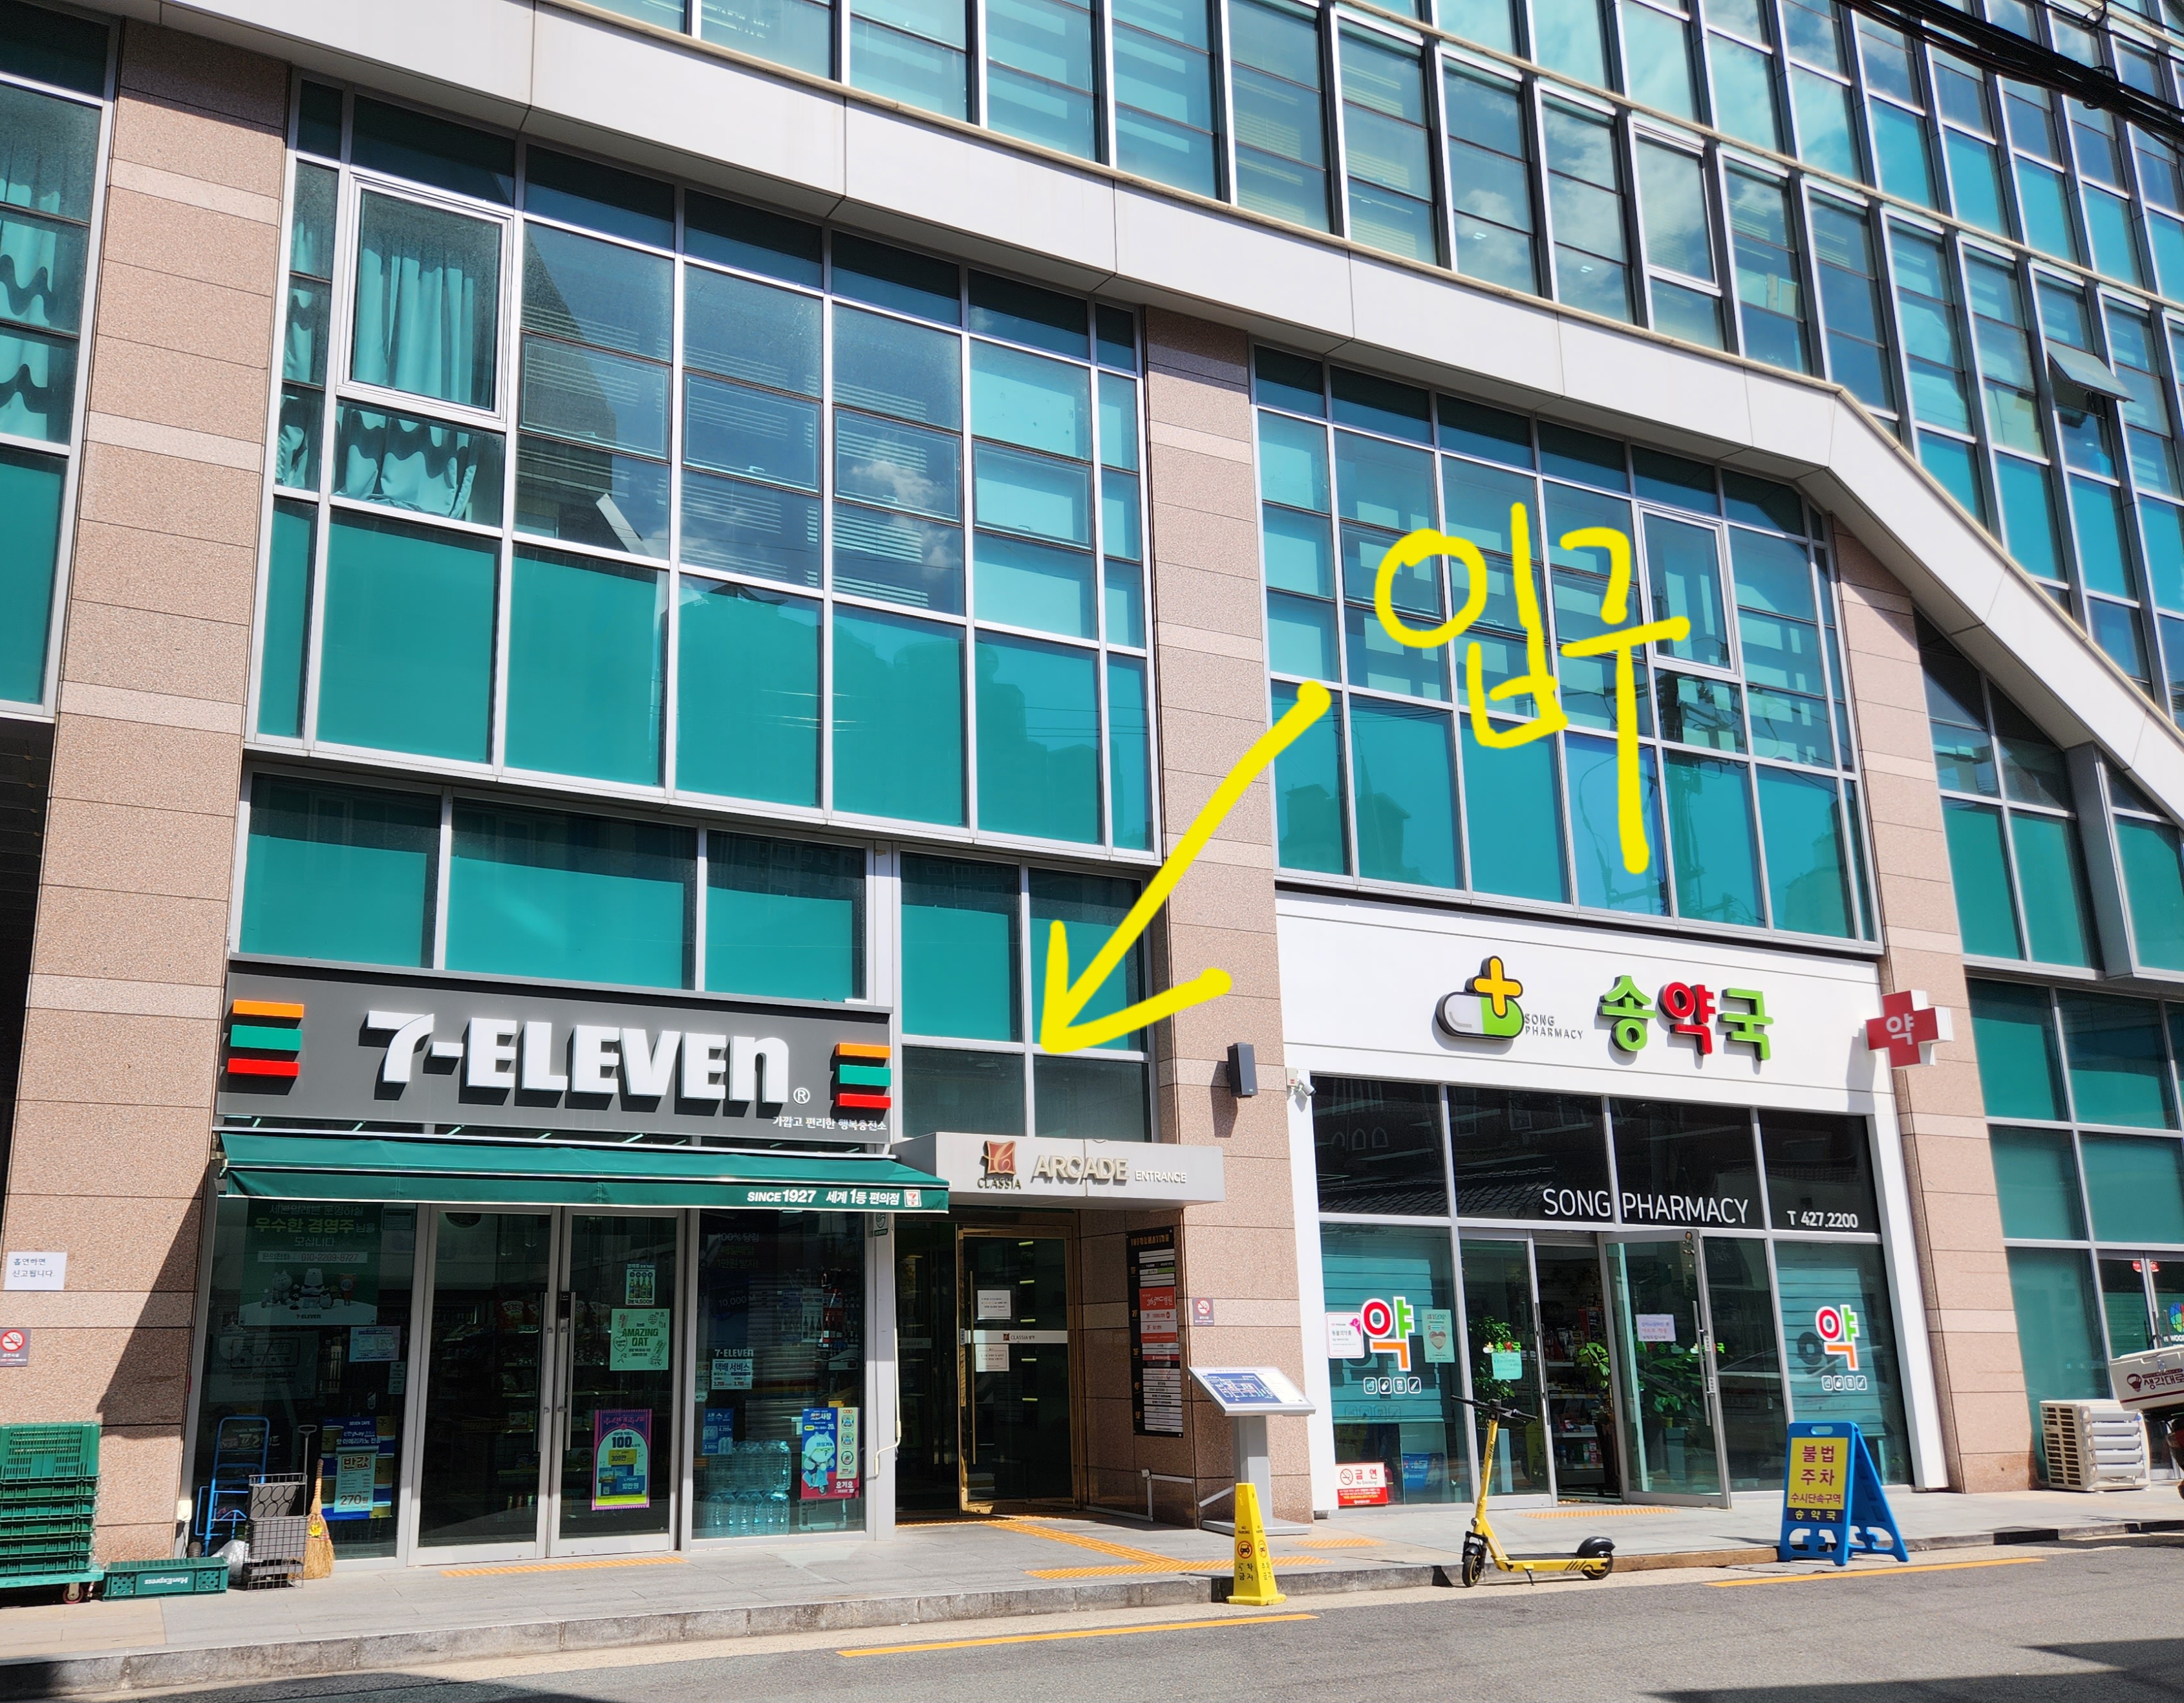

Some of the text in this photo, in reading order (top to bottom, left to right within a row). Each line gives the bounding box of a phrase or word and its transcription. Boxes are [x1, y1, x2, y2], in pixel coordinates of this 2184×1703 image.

[1525, 1013, 1555, 1026] SONG
[1597, 975, 1773, 1062] 송약국
[1525, 1025, 1583, 1040] PHARMACY
[1885, 1013, 1915, 1045] 약
[773, 1117, 887, 1131] 가깝고 편리한 행복충전소
[1034, 1155, 1187, 1184] ARCADE ENTRANCE
[977, 1177, 1022, 1190] CLASSIA
[747, 1192, 782, 1203] SINCE
[783, 1189, 817, 1203] 1927
[826, 1190, 848, 1204] 세계
[869, 1192, 901, 1205] 편의점
[324, 1205, 364, 1216] 운영하실
[1543, 1188, 1749, 1224] SONG PHARMACY
[255, 1217, 303, 1233] 우수한
[1786, 1210, 1859, 1229] T 427.2200
[294, 1236, 336, 1247] 모십니다
[622, 1328, 659, 1337] AMAZING
[1360, 1296, 1415, 1371] 약
[1815, 1304, 1860, 1371] 약
[632, 1337, 648, 1346] OAT
[715, 1362, 750, 1371] 택배 서비스
[1802, 1445, 1835, 1462] 불법
[343, 1456, 371, 1471] 반값
[1801, 1469, 1835, 1486] 주차
[1790, 1492, 1841, 1504] 수시단속구역
[1795, 1510, 1836, 1521] 송약국
[144, 1576, 189, 1585] HanExpress
